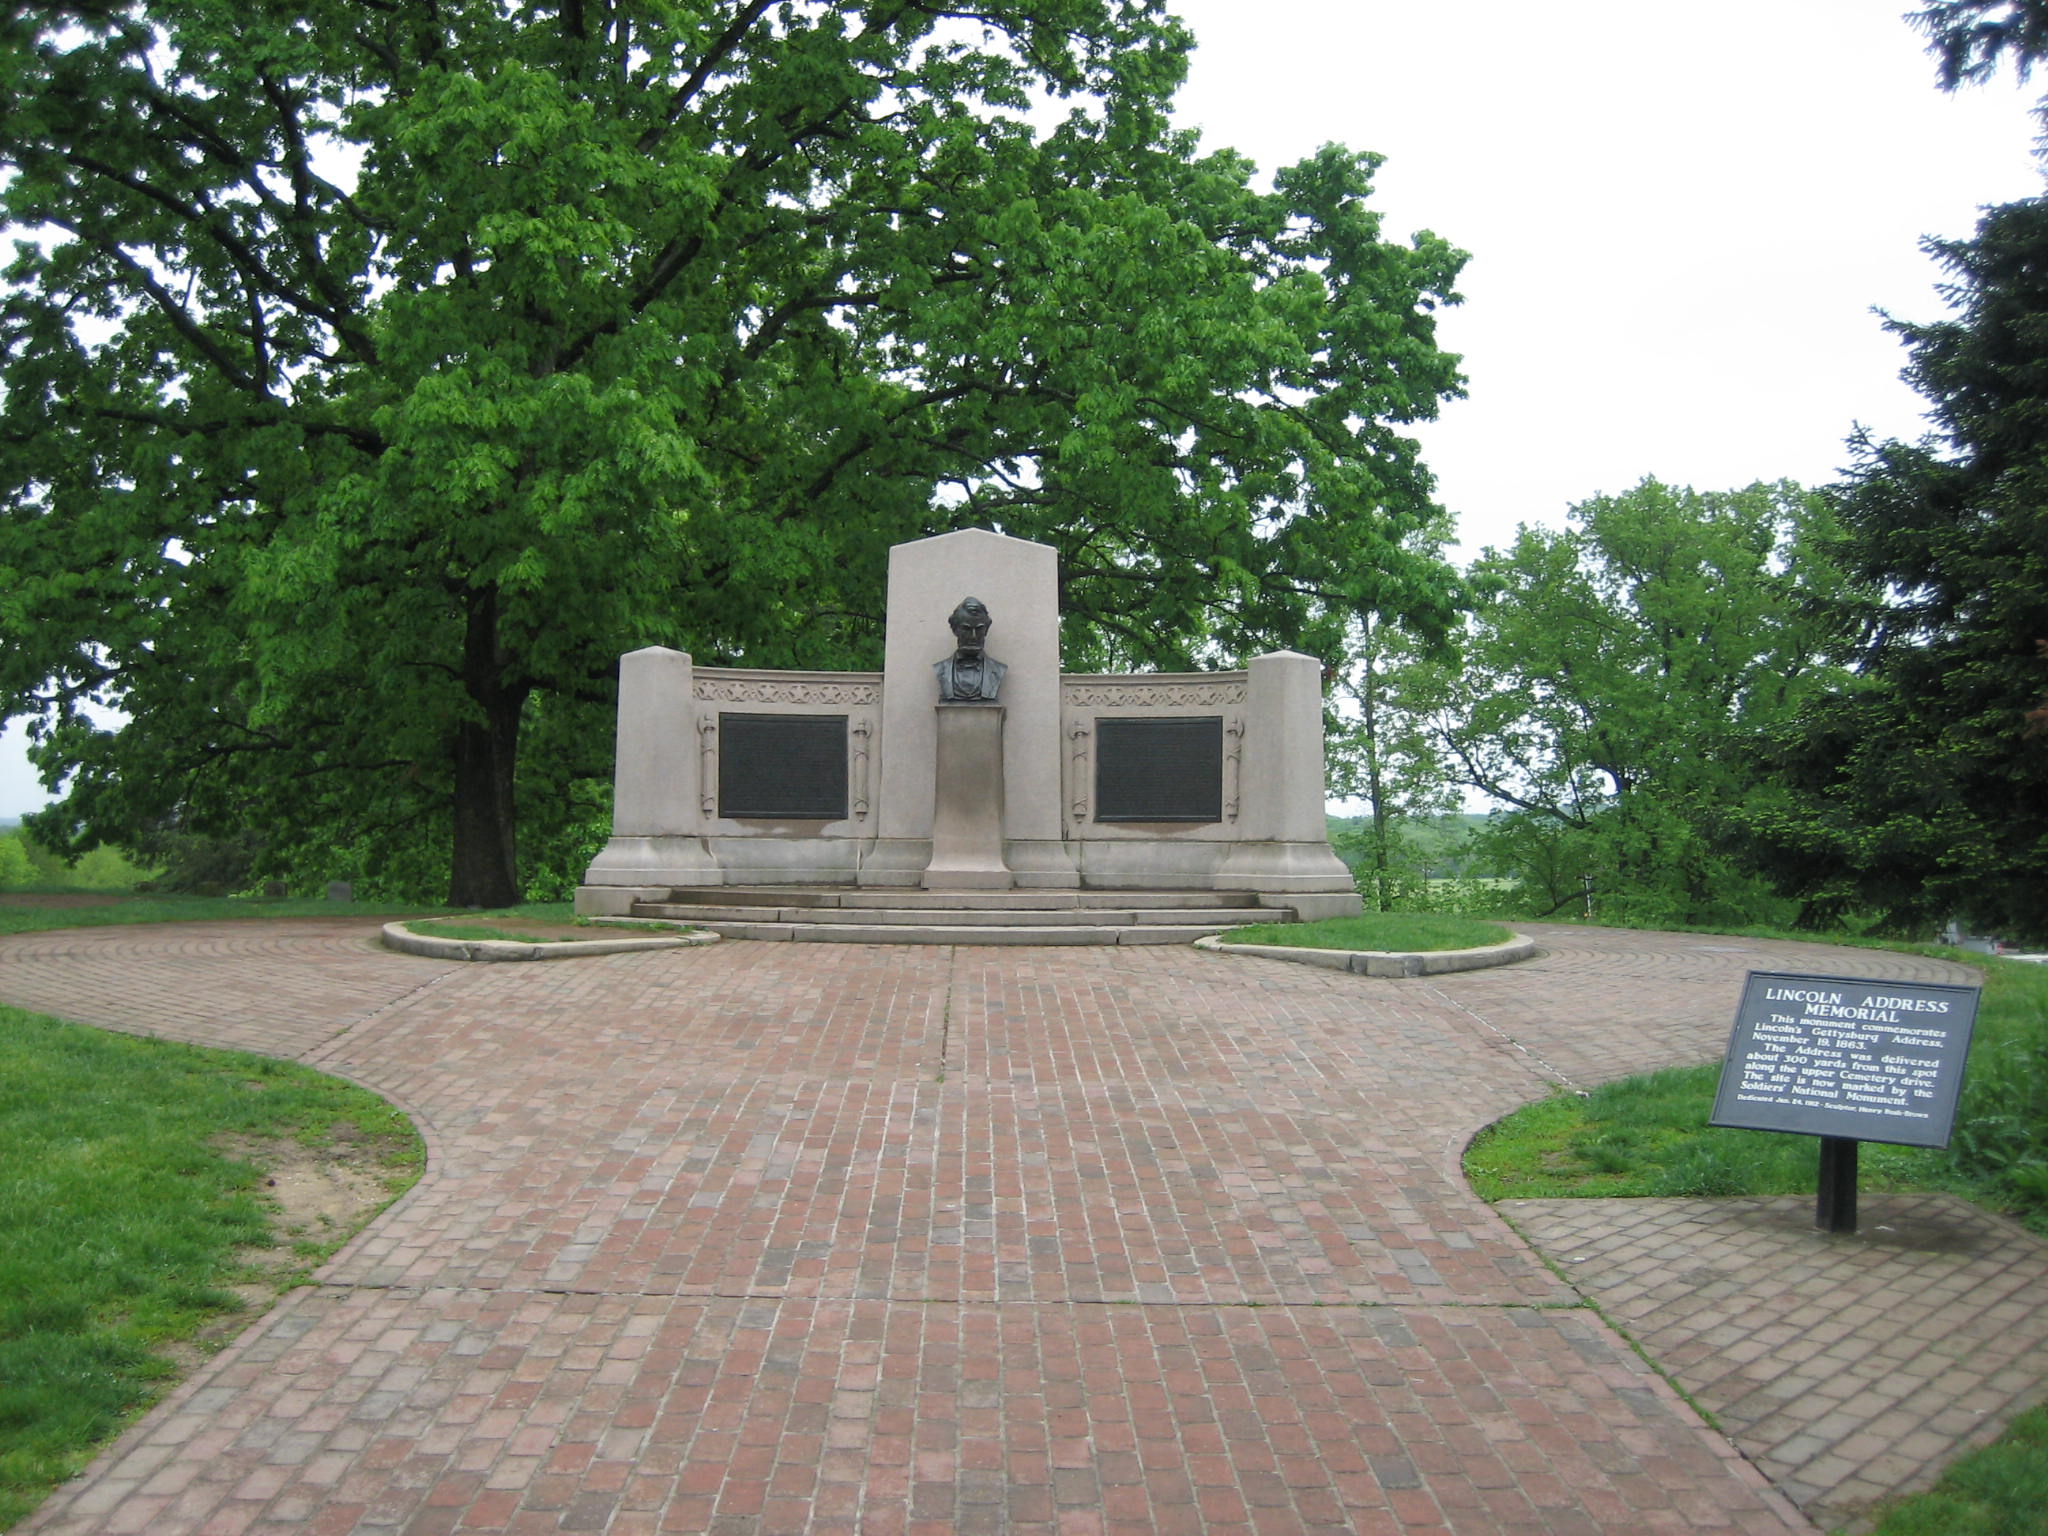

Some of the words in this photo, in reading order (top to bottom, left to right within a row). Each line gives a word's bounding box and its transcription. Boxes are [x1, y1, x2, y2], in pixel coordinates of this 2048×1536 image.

[1766, 988, 1842, 1005] LINCOLN
[1861, 996, 1949, 1013] ADDRESS
[1805, 1003, 1899, 1023] MEMORIAL
[1754, 1022, 1802, 1034] Lincoln's
[1812, 1028, 1879, 1043] Gettysburg
[1770, 1014, 1795, 1024] This
[1799, 1018, 1855, 1029] monument
[1862, 1025, 1947, 1038] commemorates
[1752, 1032, 1810, 1044] November
[1746, 1052, 1779, 1061] about
[1784, 1055, 1807, 1064] 300
[1814, 1060, 1847, 1068] yards
[1852, 1061, 1880, 1072] from
[1884, 1064, 1907, 1075] this
[1912, 1070, 1937, 1078] spot
[1765, 1043, 1786, 1052] The
[1795, 1046, 1842, 1058] Address
[1850, 1053, 1873, 1062] was
[1881, 1055, 1940, 1068] delivered
[1744, 1070, 1763, 1080] The
[1771, 1074, 1790, 1082] site
[1797, 1075, 1806, 1084] is
[1812, 1079, 1835, 1087] now
[1842, 1083, 1885, 1093] marked
[1891, 1086, 1907, 1096] by
[1914, 1089, 1933, 1098] the
[1745, 1061, 1775, 1073] along
[1780, 1065, 1797, 1073] the
[1802, 1068, 1835, 1077] upper
[1839, 1070, 1896, 1084] Cemetery
[1791, 1085, 1838, 1098] National
[1846, 1091, 1908, 1106] Monument.
[1858, 1106, 1883, 1114] Henry
